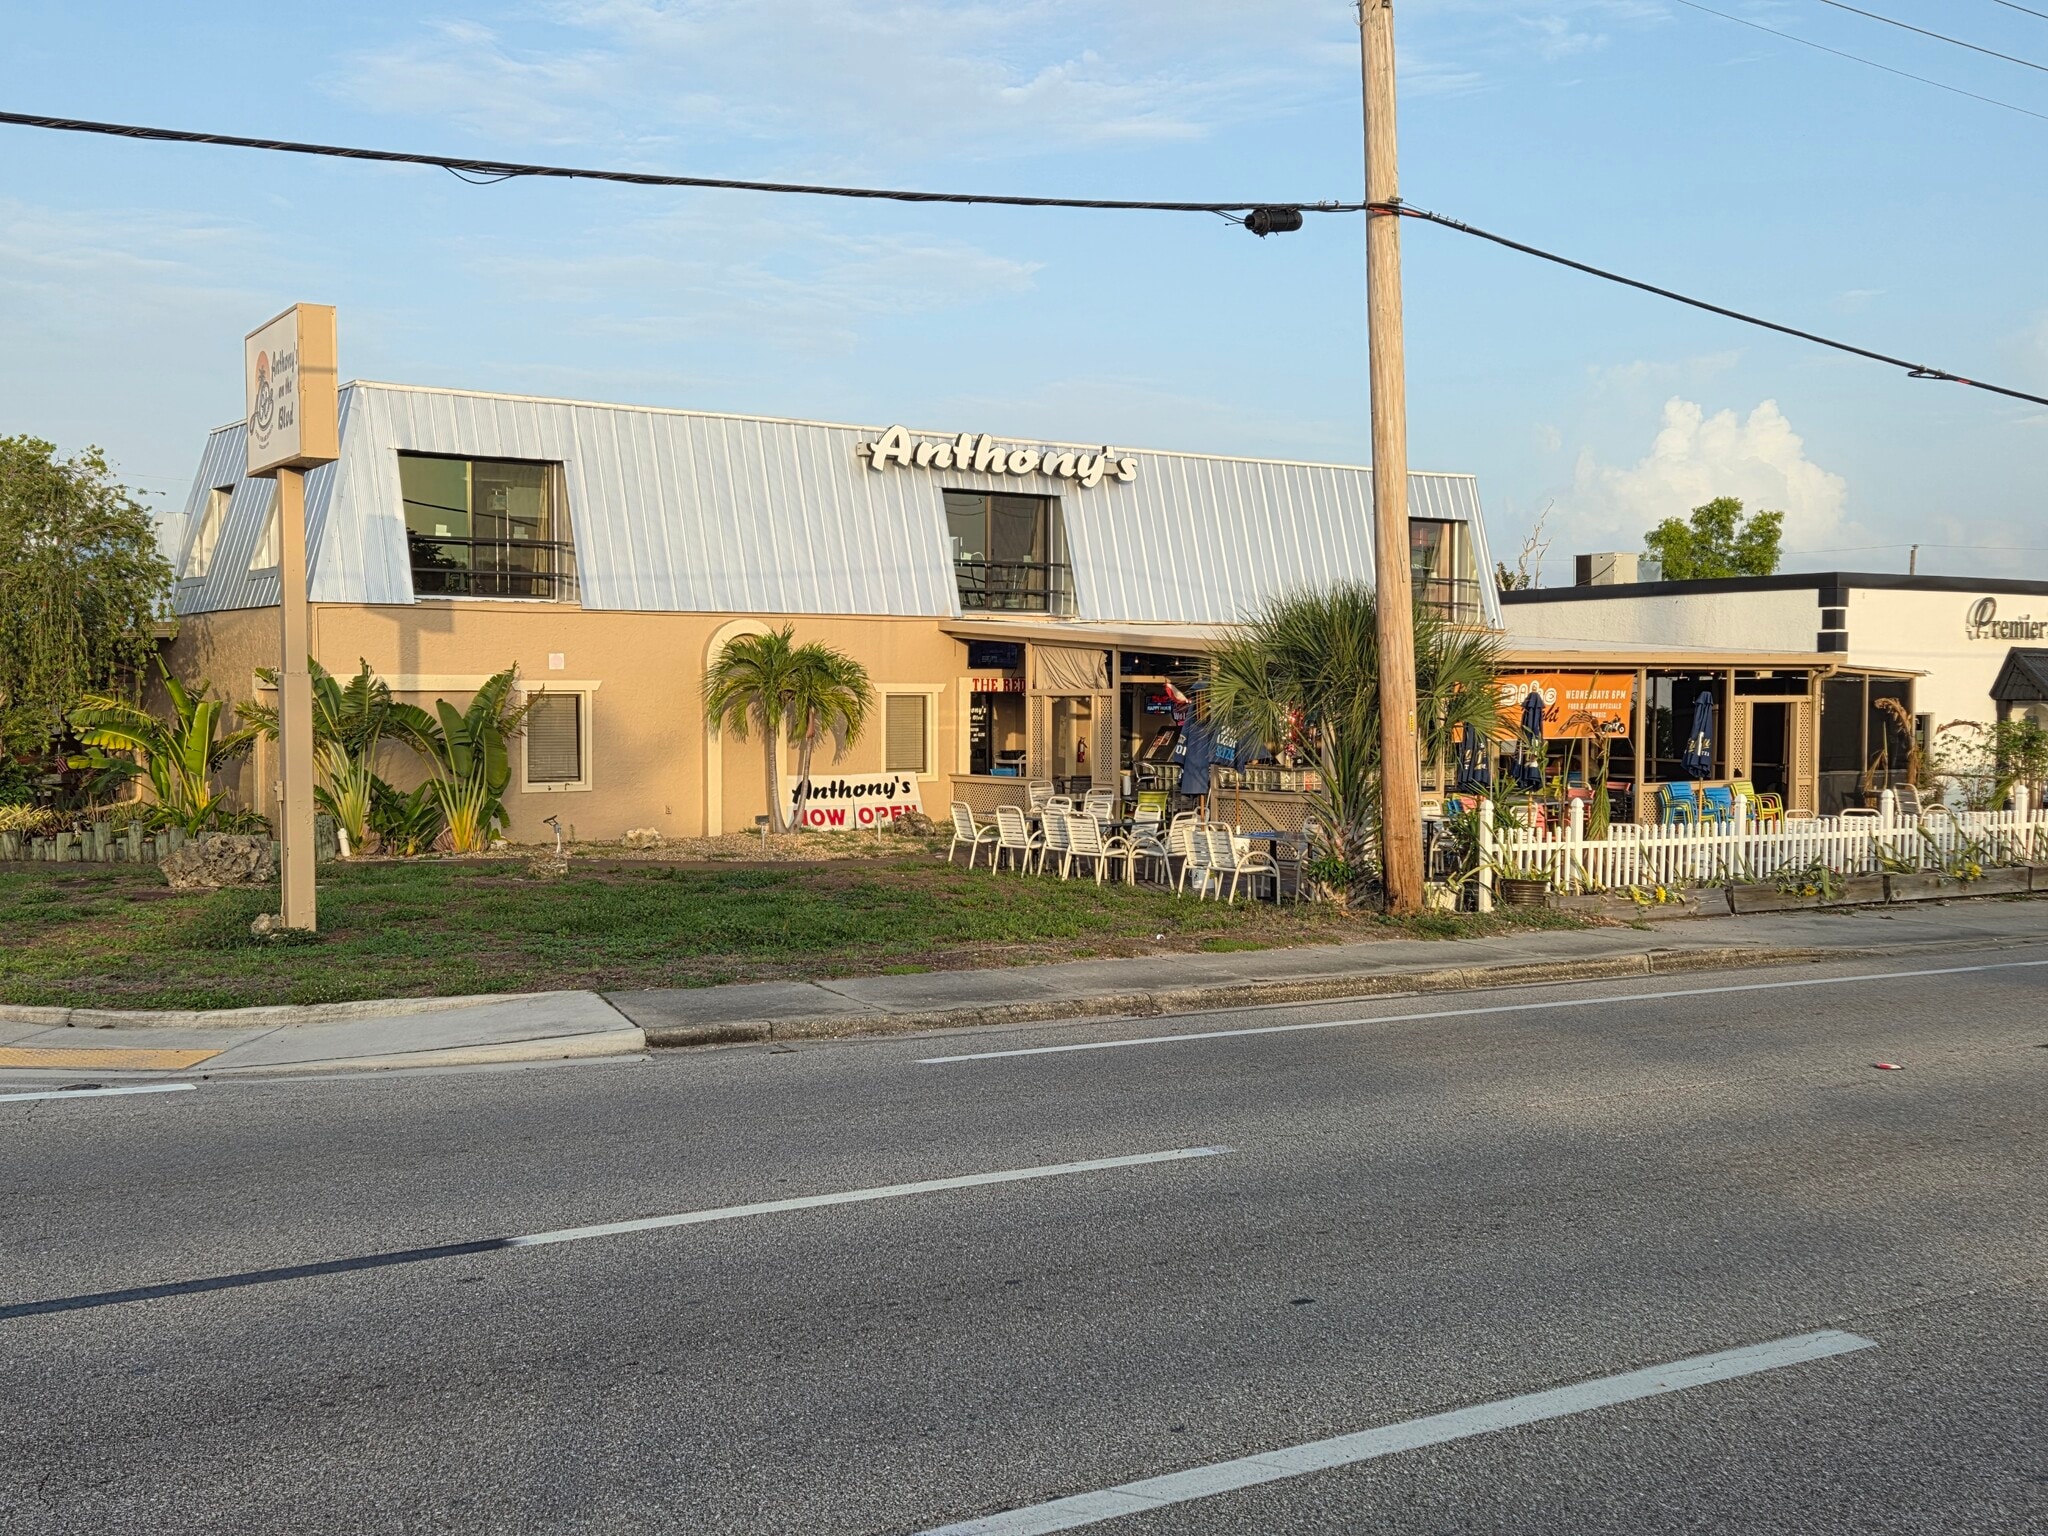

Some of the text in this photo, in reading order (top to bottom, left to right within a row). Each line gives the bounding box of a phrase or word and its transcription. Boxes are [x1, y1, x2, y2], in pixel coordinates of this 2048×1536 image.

[278, 402, 294, 430] Blvd
[869, 424, 1138, 488] Anthony's
[1966, 596, 2048, 640] Premier
[972, 678, 998, 692] THE
[1565, 690, 1626, 700] WEDNESDAYS 6PM
[1600, 702, 1621, 710] SPECIALS
[791, 775, 911, 805] Anthony's
